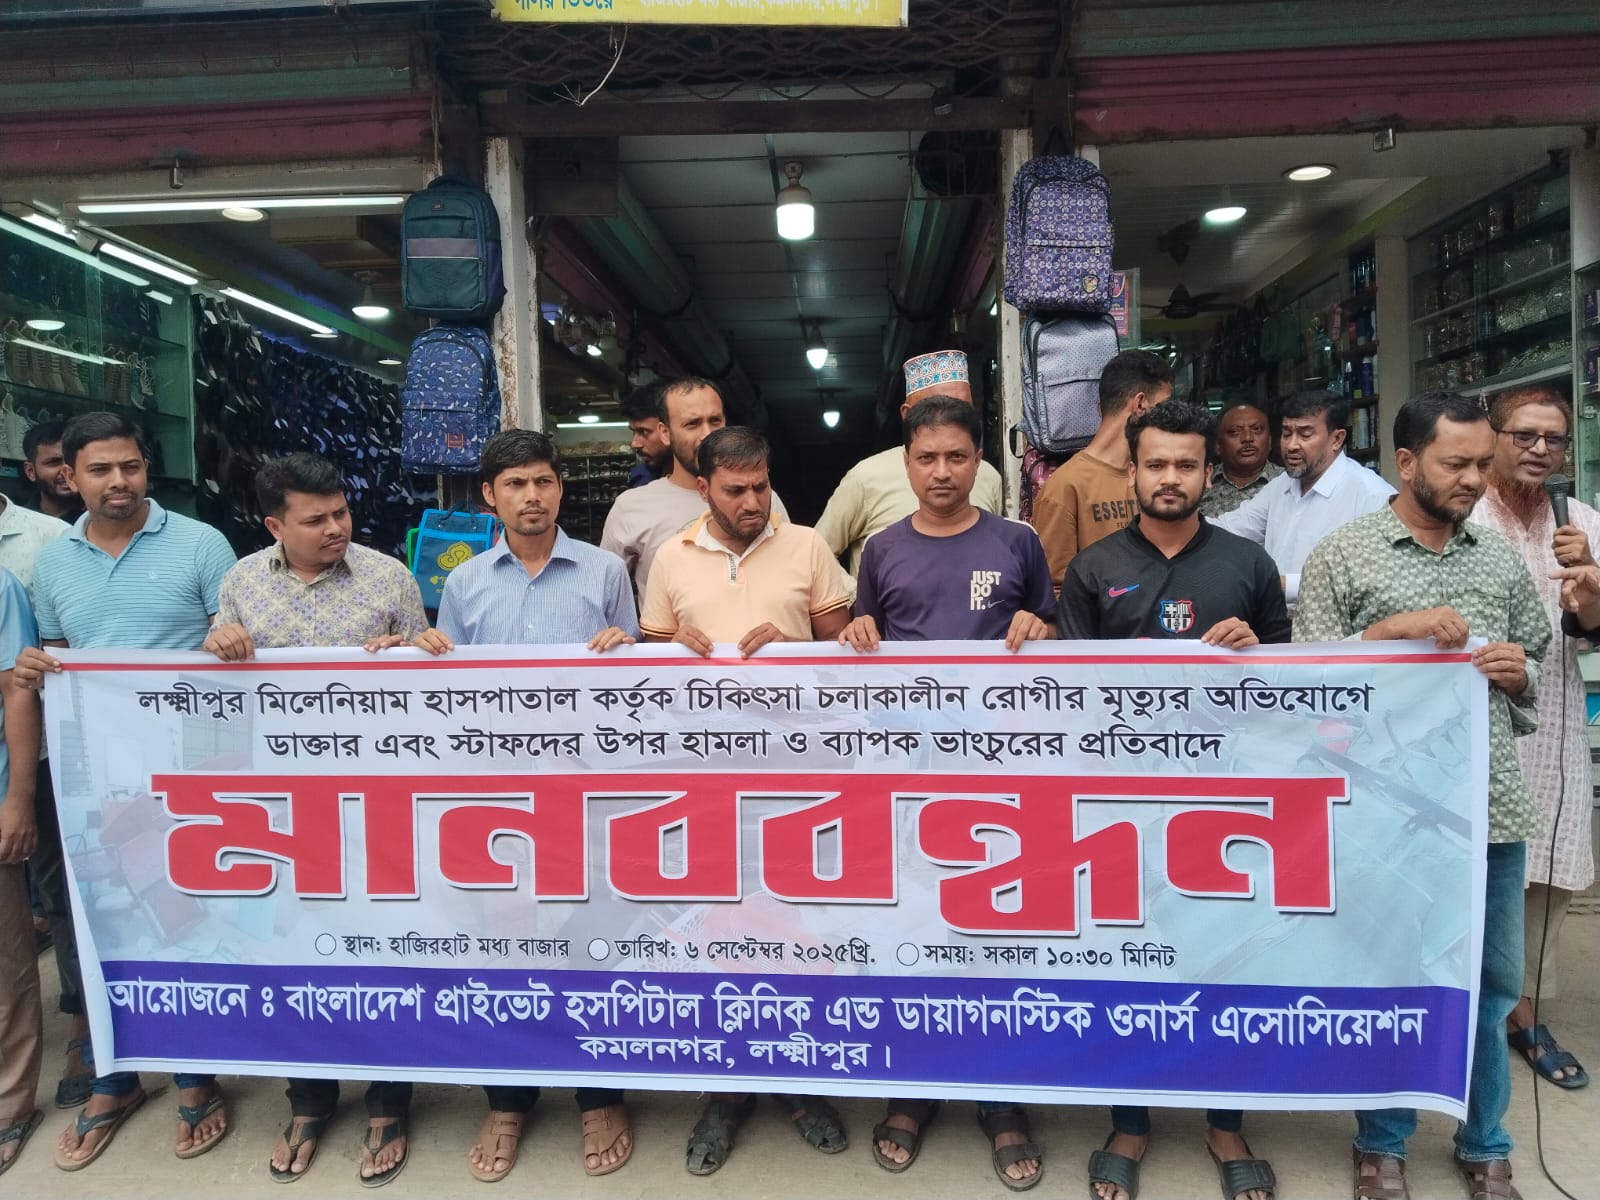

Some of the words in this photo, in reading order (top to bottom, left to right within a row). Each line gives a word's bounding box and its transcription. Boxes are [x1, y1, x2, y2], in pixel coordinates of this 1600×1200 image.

[970, 580, 991, 598] DO
[972, 570, 1002, 585] JUST
[970, 597, 986, 610] IT.
[136, 682, 247, 721] লক্ষ্মীপুর
[255, 682, 413, 716] মিলেনিয়াম
[420, 685, 581, 718] হাসপাতাল
[589, 678, 676, 722] কর্তৃক
[684, 678, 804, 712] চিকিৎসা
[814, 677, 970, 712] চলাকালীন
[982, 677, 1089, 712] রোগীর
[1097, 686, 1195, 722] মৃত্যুর
[1203, 678, 1376, 713] অভিযোগে
[264, 730, 363, 760] ডাক্তার
[375, 733, 440, 760] এবং
[447, 725, 585, 758] স্টাফদের
[593, 724, 671, 756] উপর
[679, 729, 772, 759] হামলা
[782, 734, 808, 755] ও
[819, 729, 922, 758] ব্যাপক
[931, 729, 1069, 765] ভাংচুরের
[1078, 723, 1227, 761] প্রতিবাদে
[149, 773, 1352, 938] মানববন্ধন
[341, 935, 381, 957] স্থান:
[387, 931, 470, 958] হাজিরহাট
[476, 938, 511, 957] মধ্য
[517, 938, 571, 958] বাজার
[613, 934, 676, 960] তারিখ:
[684, 941, 699, 959] ৬
[707, 935, 786, 961] সেপ্টেম্বর
[922, 944, 975, 965] সময়:
[982, 944, 1039, 966] সকাল
[1047, 947, 1113, 967] ১০:৩০
[1119, 942, 1177, 969] মিনিট
[107, 976, 251, 1017] আয়োজনে
[282, 982, 425, 1024] বাংলাদেশ
[434, 977, 555, 1028] প্রাইভেট
[562, 979, 704, 1032] হসপিটাল
[711, 981, 814, 1033] ক্লিনিক
[891, 986, 1096, 1039] ডায়াগনস্টিক
[1105, 991, 1201, 1043] ওনার্স
[1212, 995, 1429, 1047] এসোসিয়েশন
[575, 1035, 736, 1069] কমলনগর,
[746, 1032, 872, 1073] লক্ষ্মীপুর
